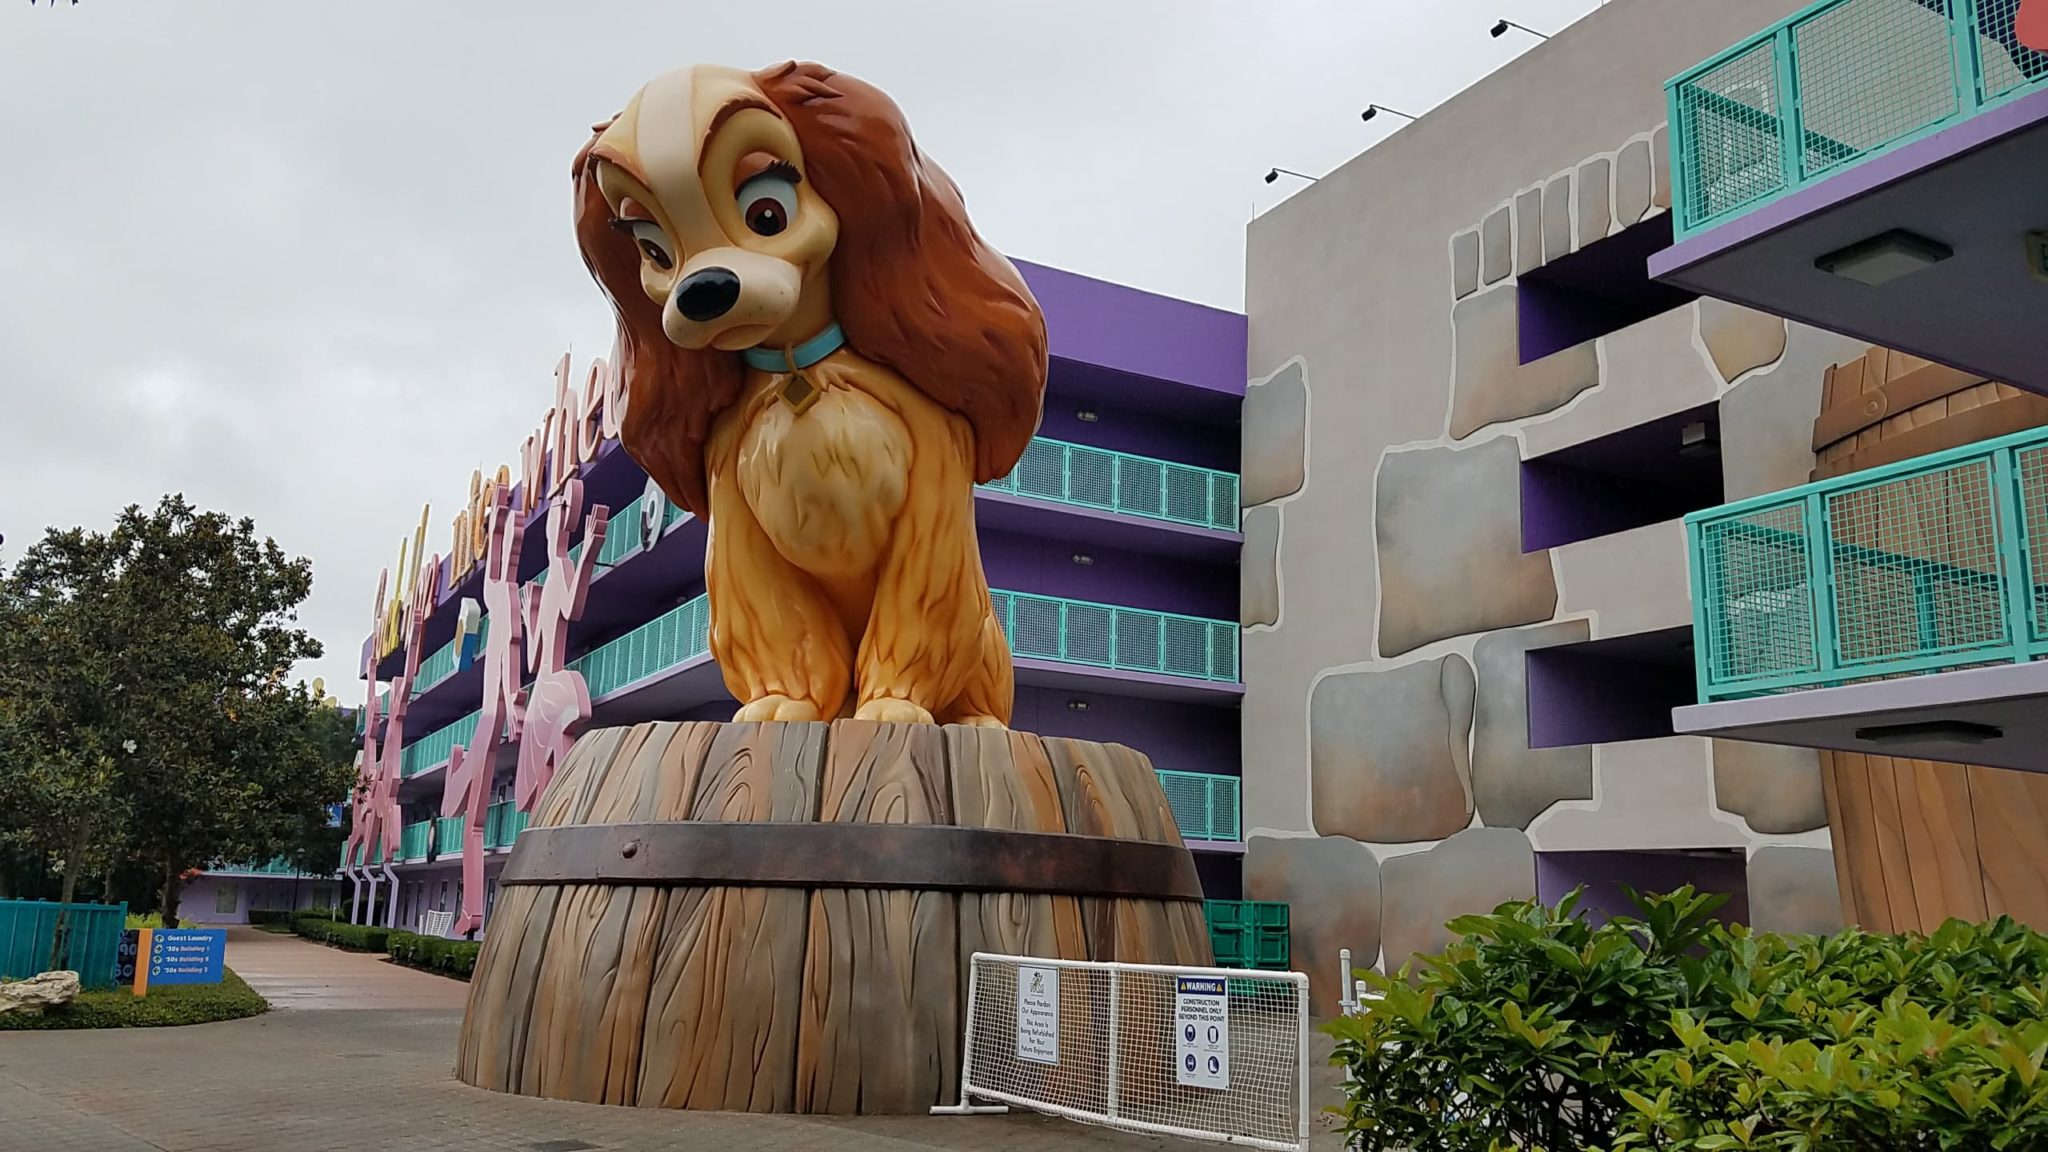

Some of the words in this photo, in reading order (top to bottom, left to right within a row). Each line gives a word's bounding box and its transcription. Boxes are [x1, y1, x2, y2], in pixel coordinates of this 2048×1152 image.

[187, 935, 213, 943] Laundry
[178, 966, 203, 974] Building
[1186, 981, 1216, 992] WARNING
[1024, 998, 1036, 1006] Please
[1036, 1000, 1050, 1008] Pardon
[1183, 998, 1220, 1006] CONSTRUCTION
[1030, 1008, 1054, 1017] Appearance
[1180, 1006, 1208, 1014] PERSONNEL
[1209, 1007, 1222, 1015] ONLY
[1178, 1013, 1198, 1021] BEYOND
[1034, 1020, 1044, 1028] Area
[1020, 1027, 1031, 1036] Being
[1032, 1028, 1055, 1038] Refurbished
[1021, 1045, 1033, 1053] Future
